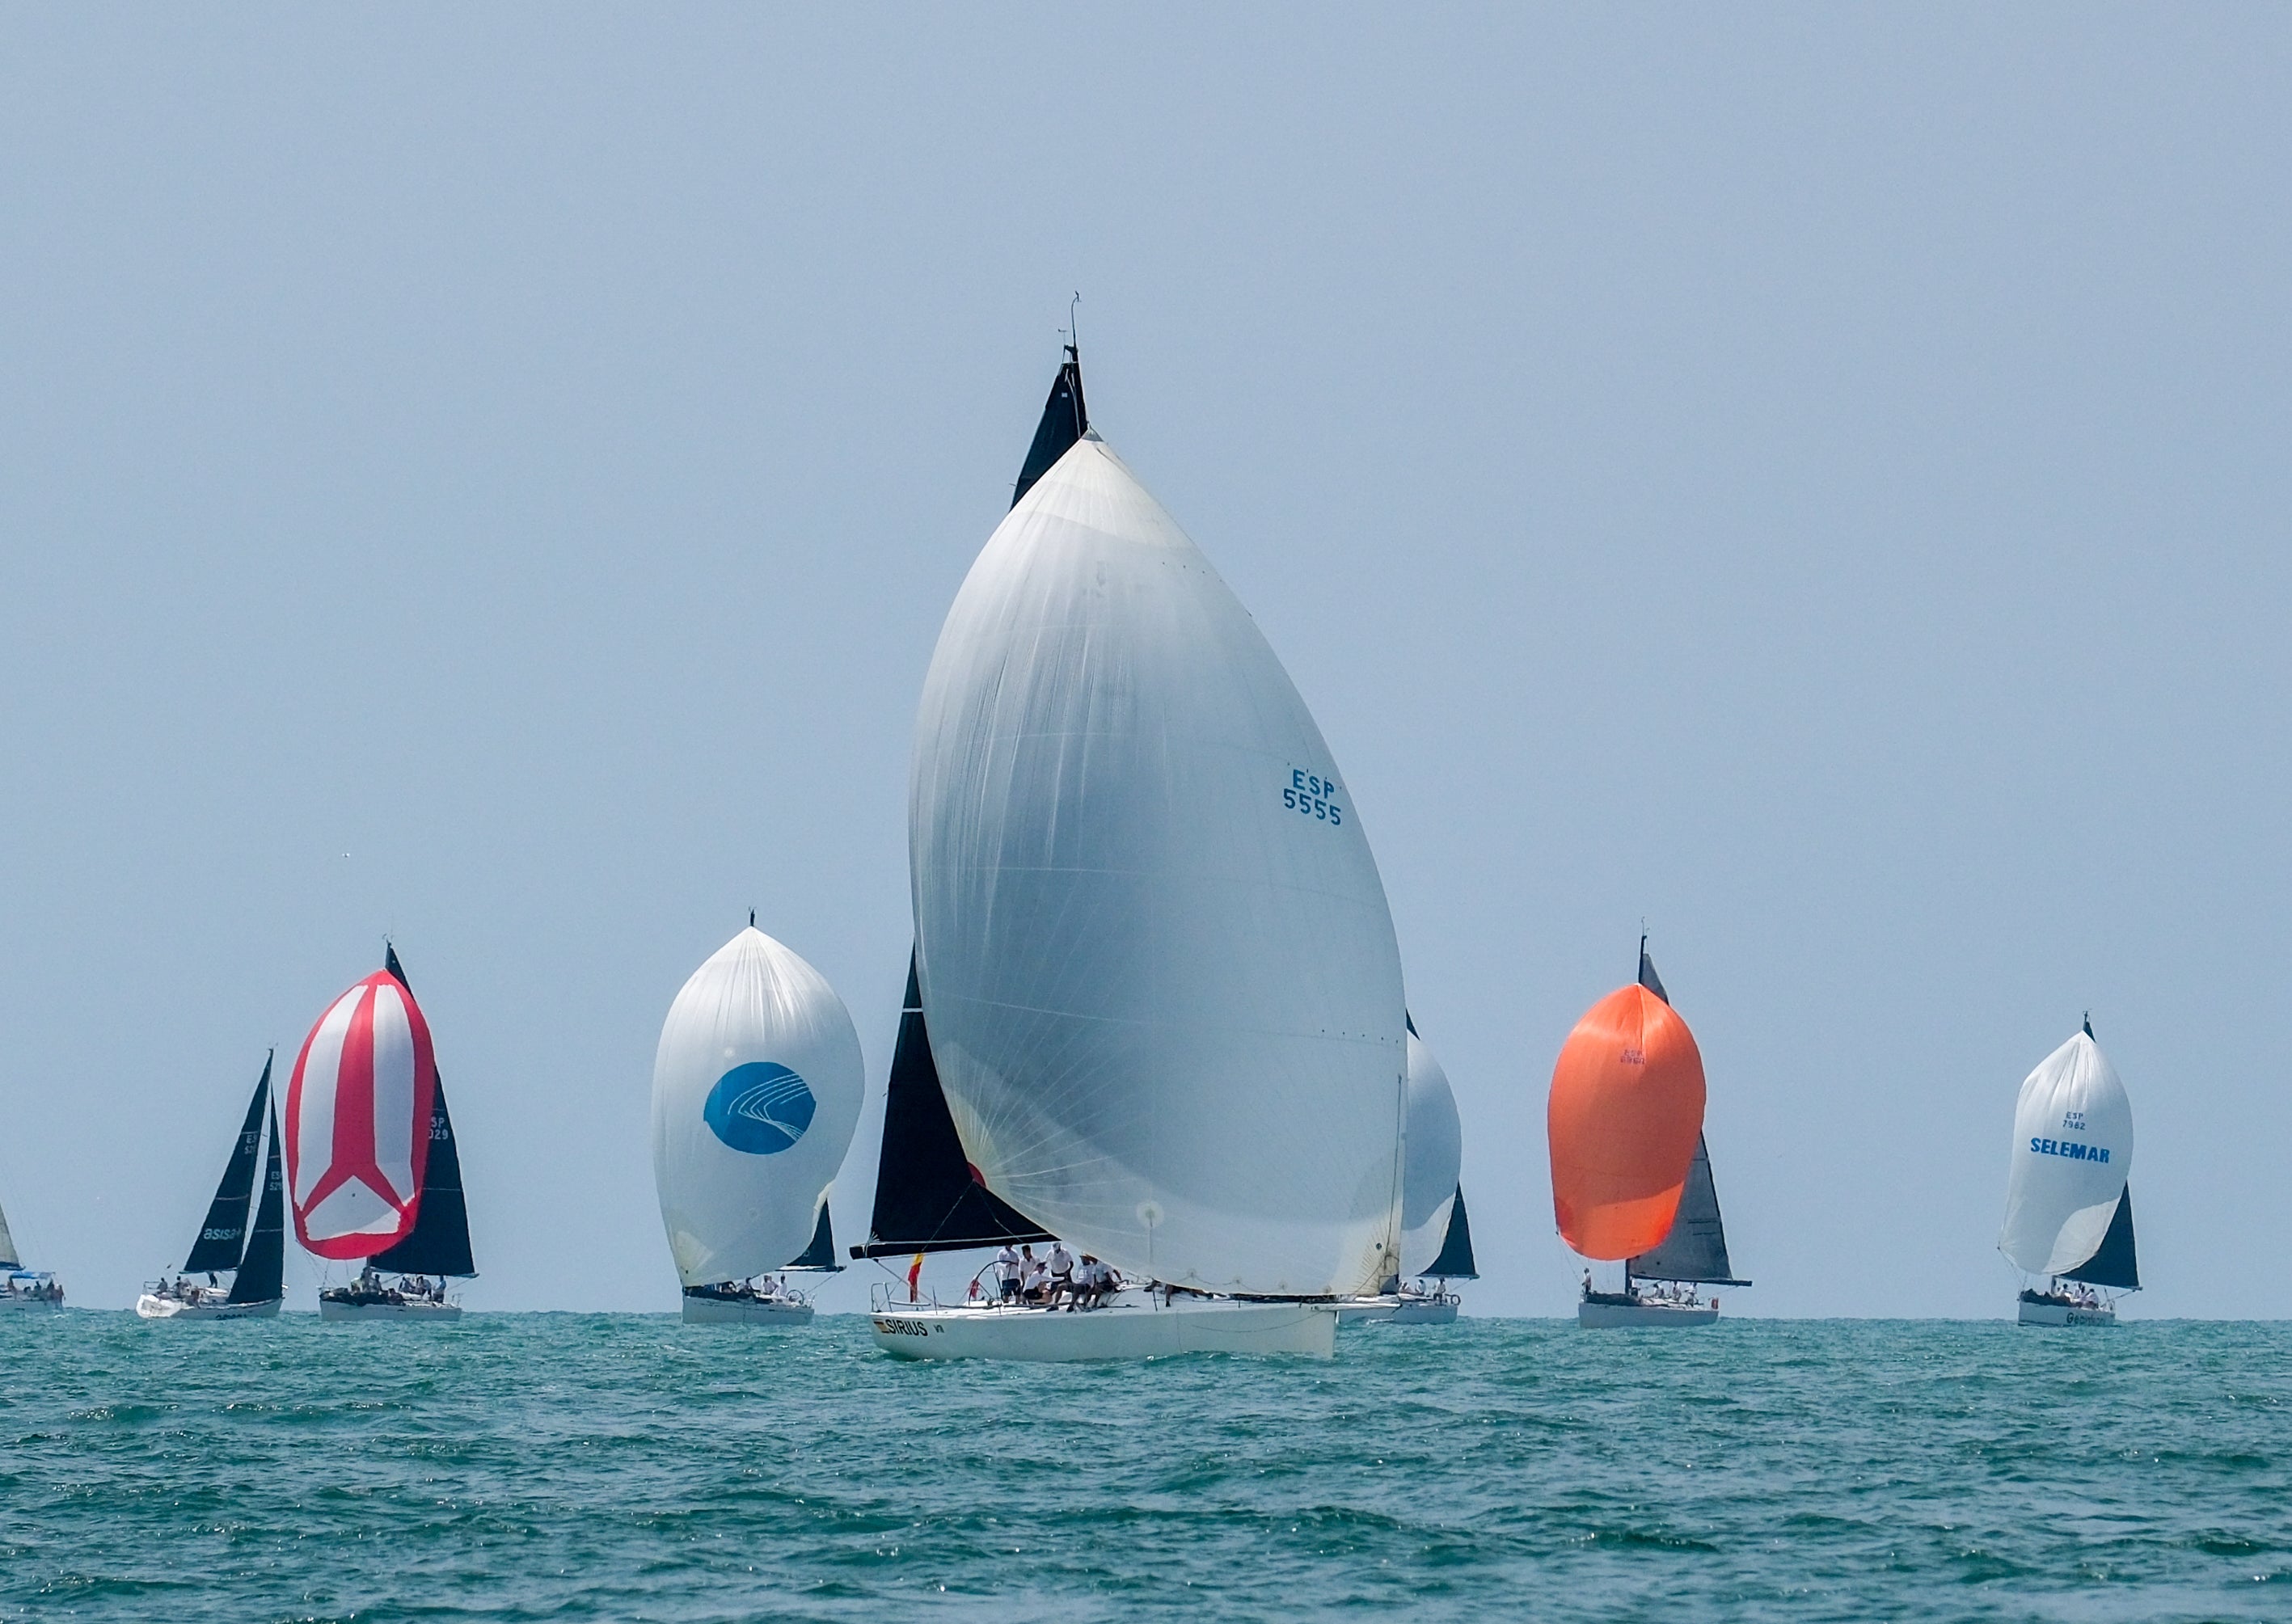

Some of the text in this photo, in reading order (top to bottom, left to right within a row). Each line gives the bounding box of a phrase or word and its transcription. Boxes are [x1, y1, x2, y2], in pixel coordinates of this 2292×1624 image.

[1293, 769, 1335, 799] ESP
[1284, 788, 1341, 825] 5555
[430, 1116, 445, 1128] SP
[2066, 1111, 2083, 1120] ESP
[2030, 1137, 2110, 1163] SELEMAR
[885, 1319, 928, 1336] SIRIUS
